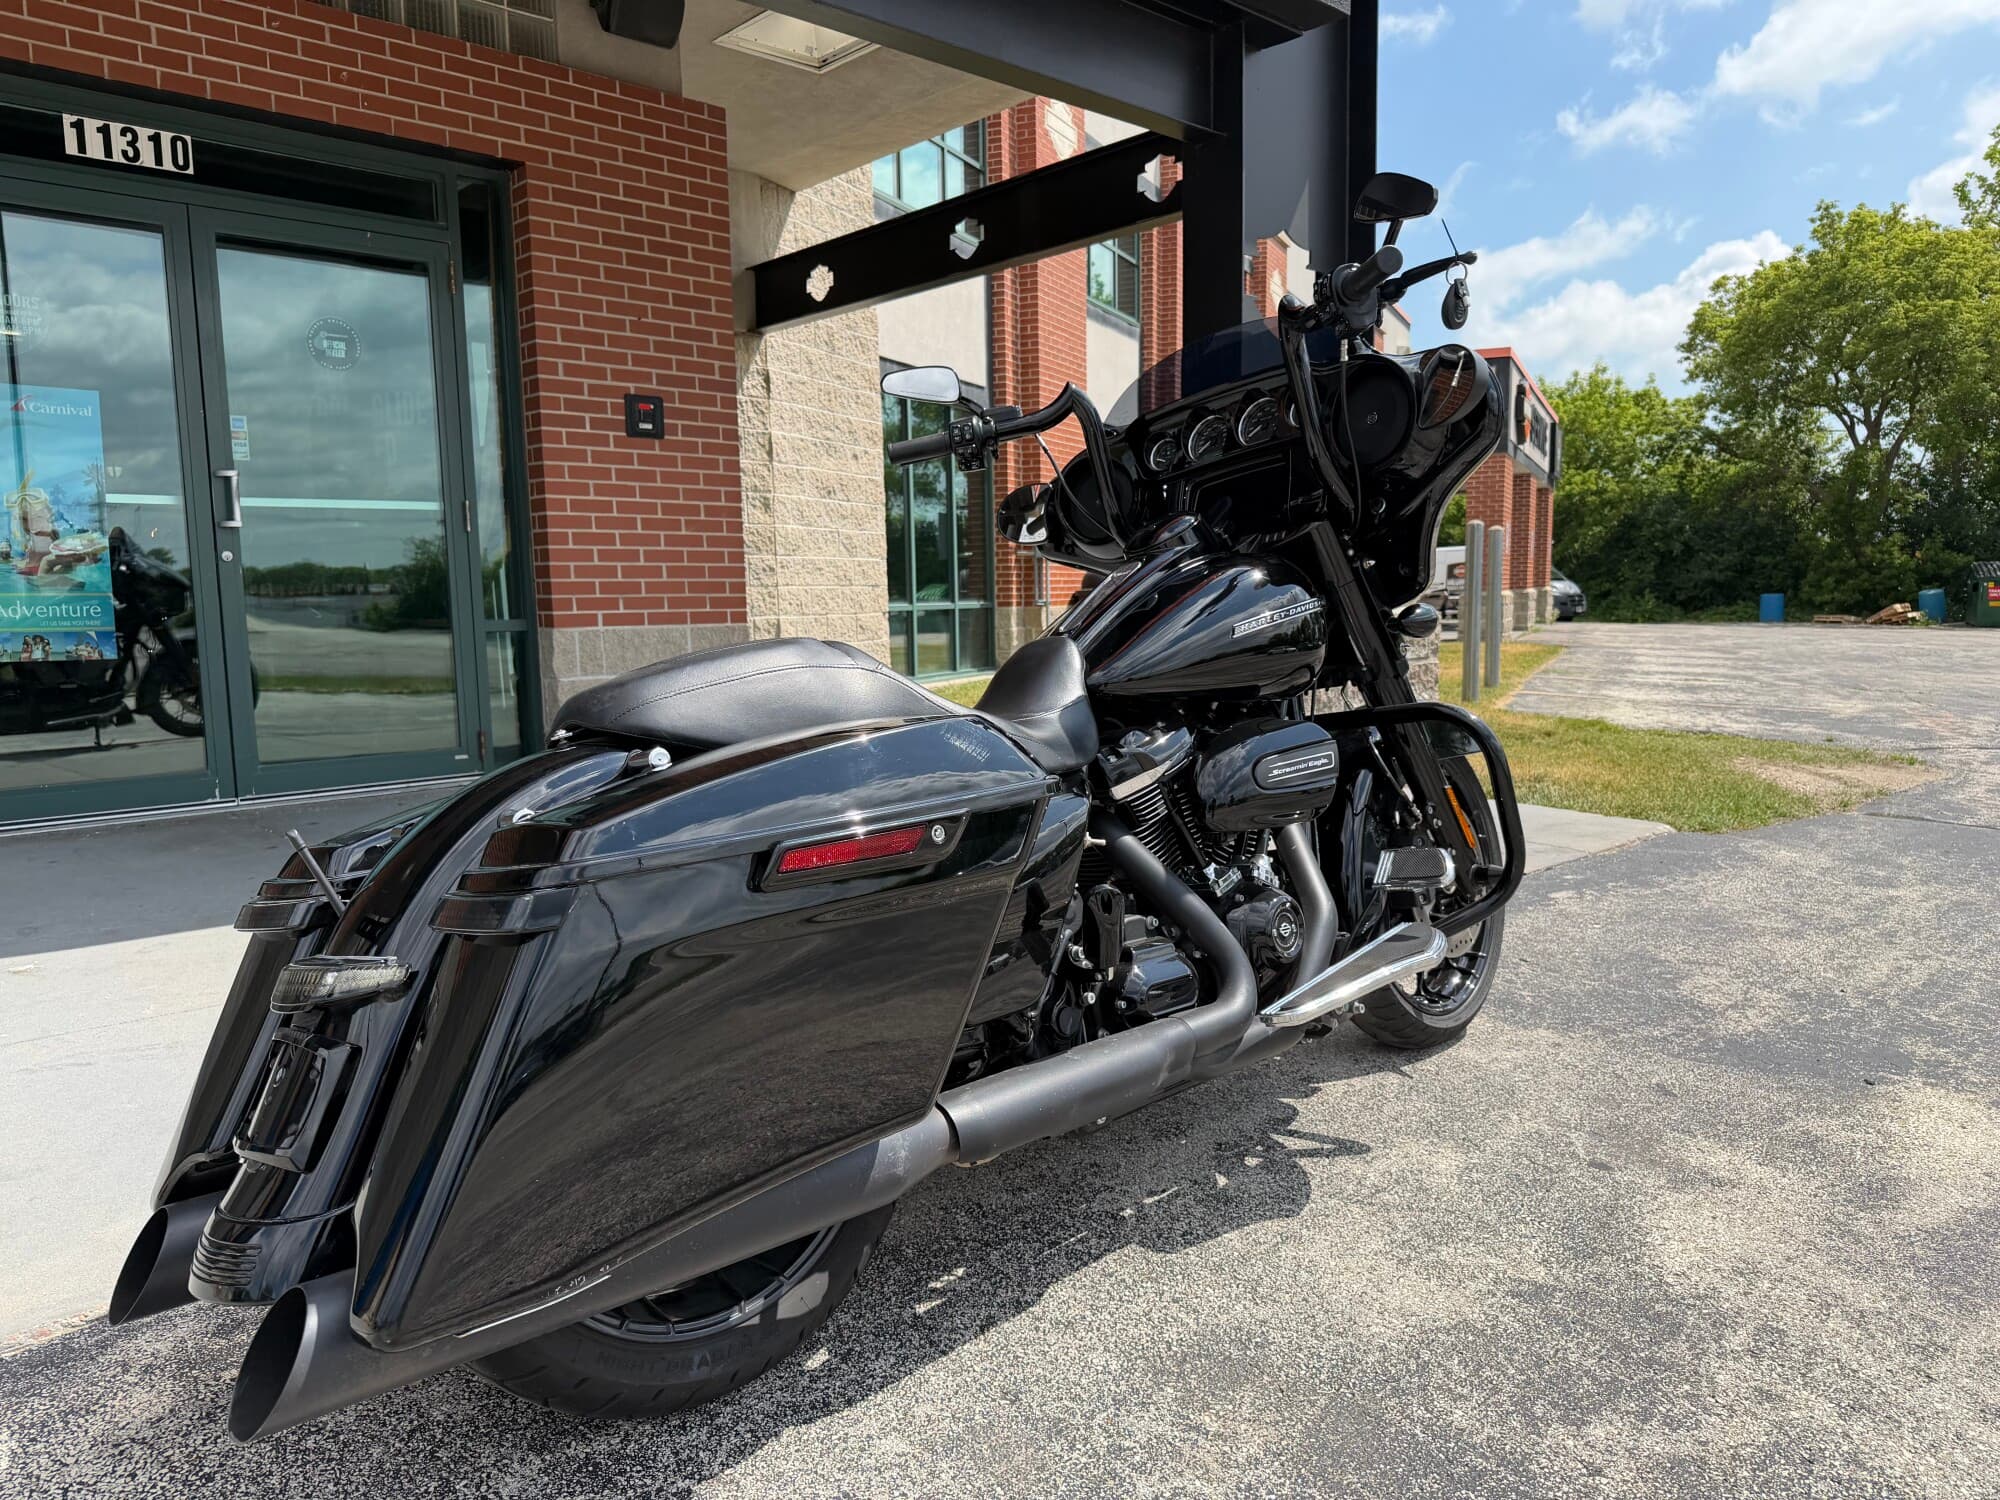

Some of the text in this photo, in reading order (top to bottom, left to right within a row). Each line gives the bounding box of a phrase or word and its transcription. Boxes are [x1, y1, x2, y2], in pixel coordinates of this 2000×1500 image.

[69, 117, 191, 172] 11310
[30, 402, 92, 417] Carnival
[1234, 600, 1321, 636] HARLEY-DAVIDS
